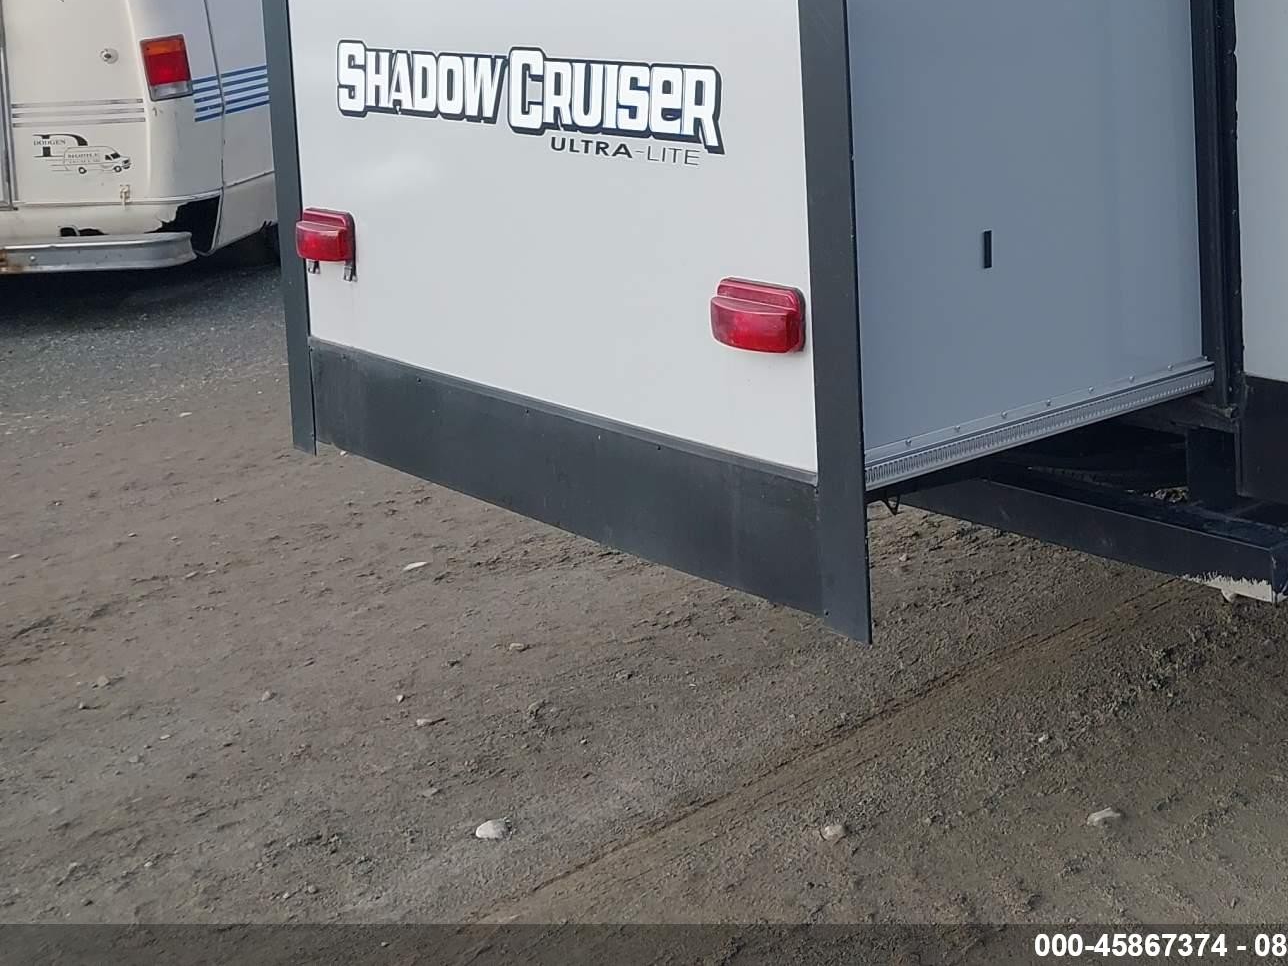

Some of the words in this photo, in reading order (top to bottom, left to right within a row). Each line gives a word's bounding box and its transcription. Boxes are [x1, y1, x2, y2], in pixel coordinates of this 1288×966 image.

[337, 40, 508, 124] SHADOW
[508, 46, 725, 155] CRUISER
[550, 136, 701, 166] ULTRA-LITE
